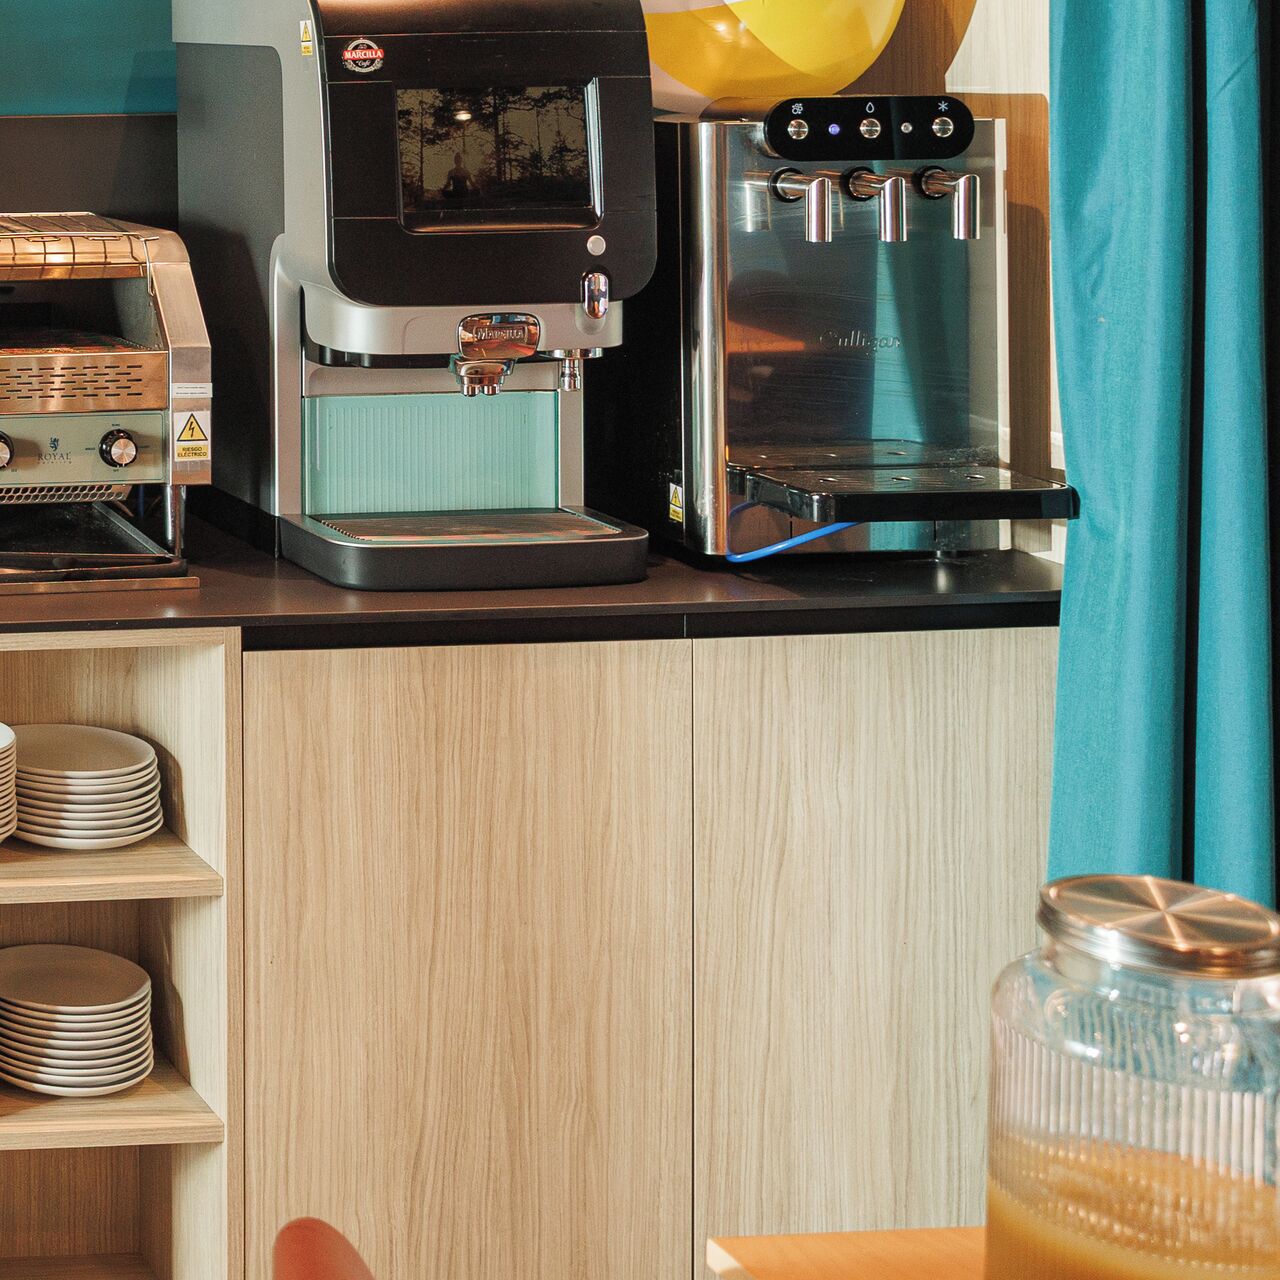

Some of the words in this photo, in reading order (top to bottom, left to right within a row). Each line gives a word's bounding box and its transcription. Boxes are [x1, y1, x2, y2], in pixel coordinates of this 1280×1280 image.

[345, 51, 383, 59] MARCILLA
[477, 328, 524, 340] MARCILLA
[819, 330, 901, 356] Culligan
[38, 452, 70, 461] ROYAL
